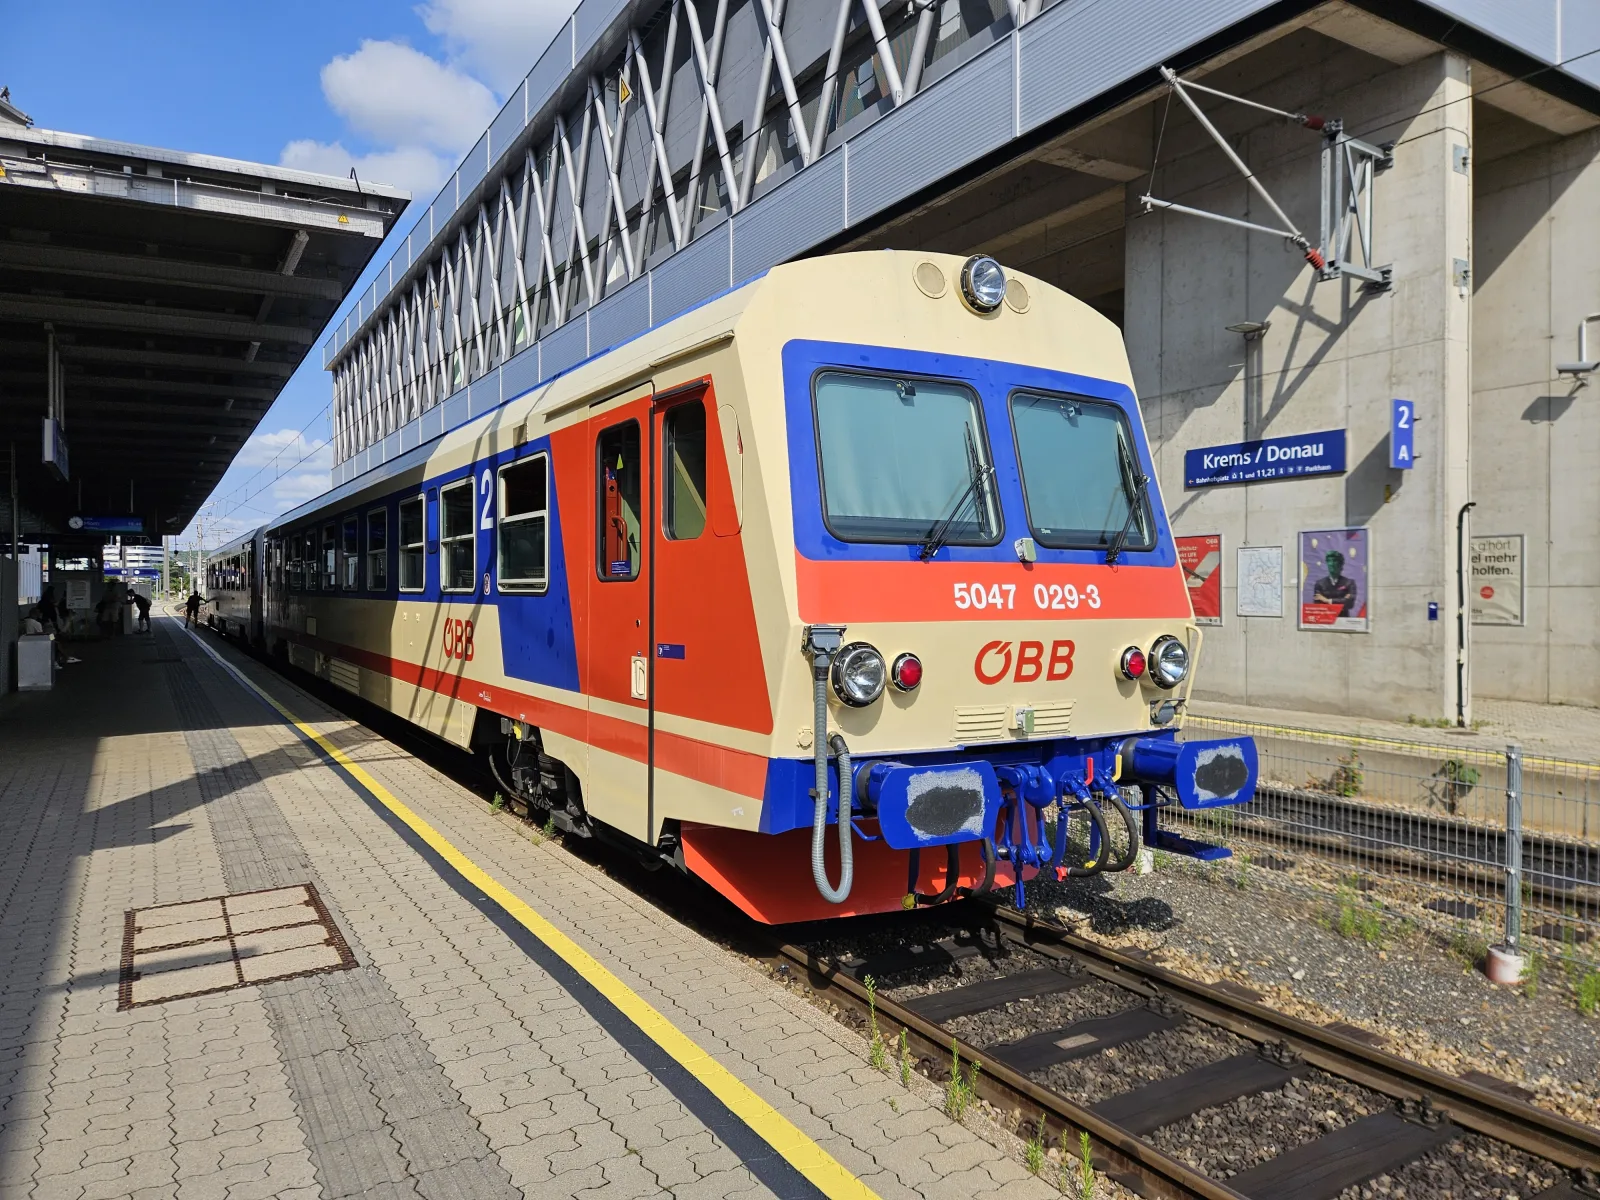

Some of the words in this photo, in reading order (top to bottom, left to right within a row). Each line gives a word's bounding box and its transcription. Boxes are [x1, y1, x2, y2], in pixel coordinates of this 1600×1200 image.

[1397, 405, 1410, 429] 2
[1203, 452, 1251, 469] Krems
[1254, 447, 1263, 464] /
[1266, 443, 1324, 462] Donau
[1397, 444, 1410, 461] A
[480, 468, 494, 531] 2
[1484, 552, 1518, 563] mehr
[953, 582, 1017, 610] 5047
[1033, 583, 1102, 610] 029-3
[442, 617, 475, 662] ÖBB
[974, 639, 1076, 686] ÖBB
